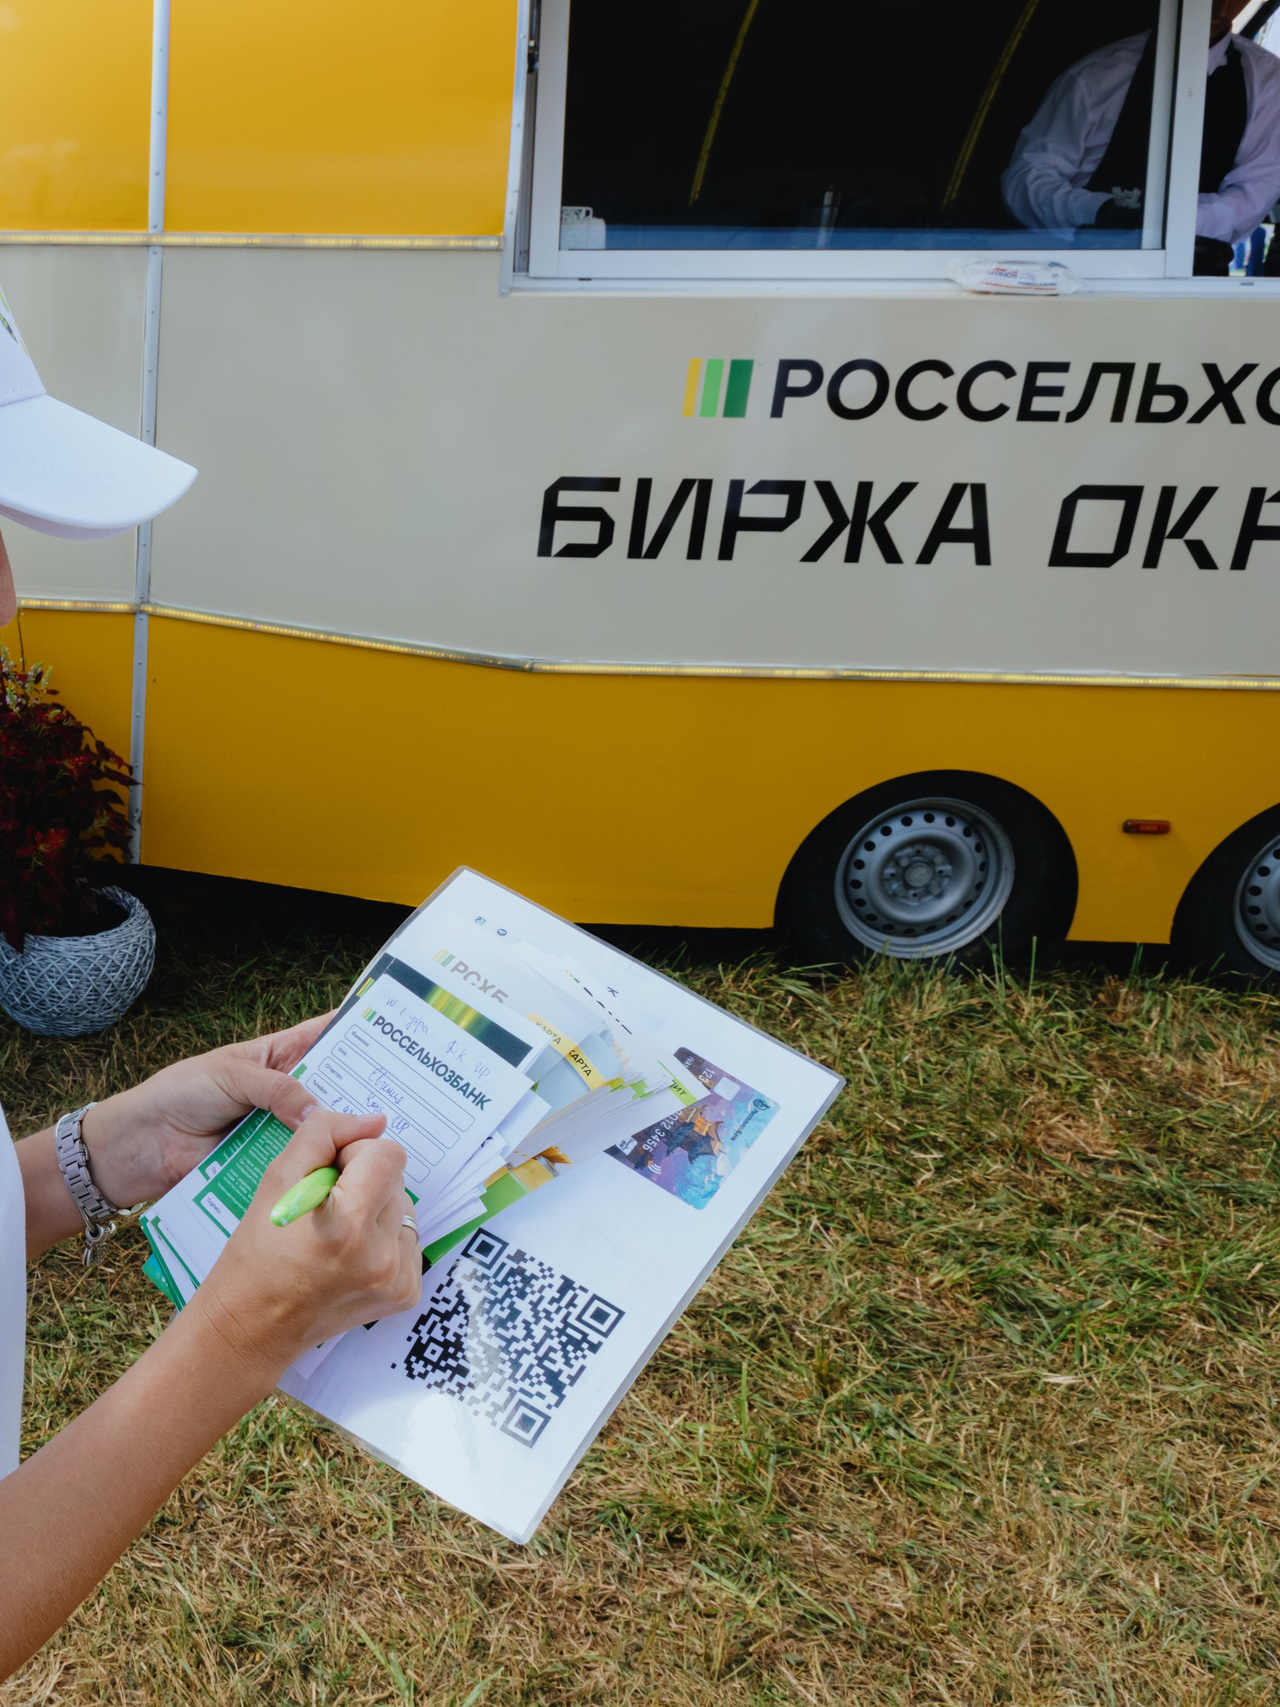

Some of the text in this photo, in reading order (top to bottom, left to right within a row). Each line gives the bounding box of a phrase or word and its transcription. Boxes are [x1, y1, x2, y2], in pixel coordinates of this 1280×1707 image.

[537, 475, 992, 566] БИРЖА
[372, 1015, 493, 1111] РОССЕЛЬХОЗБАНК
[642, 1128, 666, 1152] 3456
